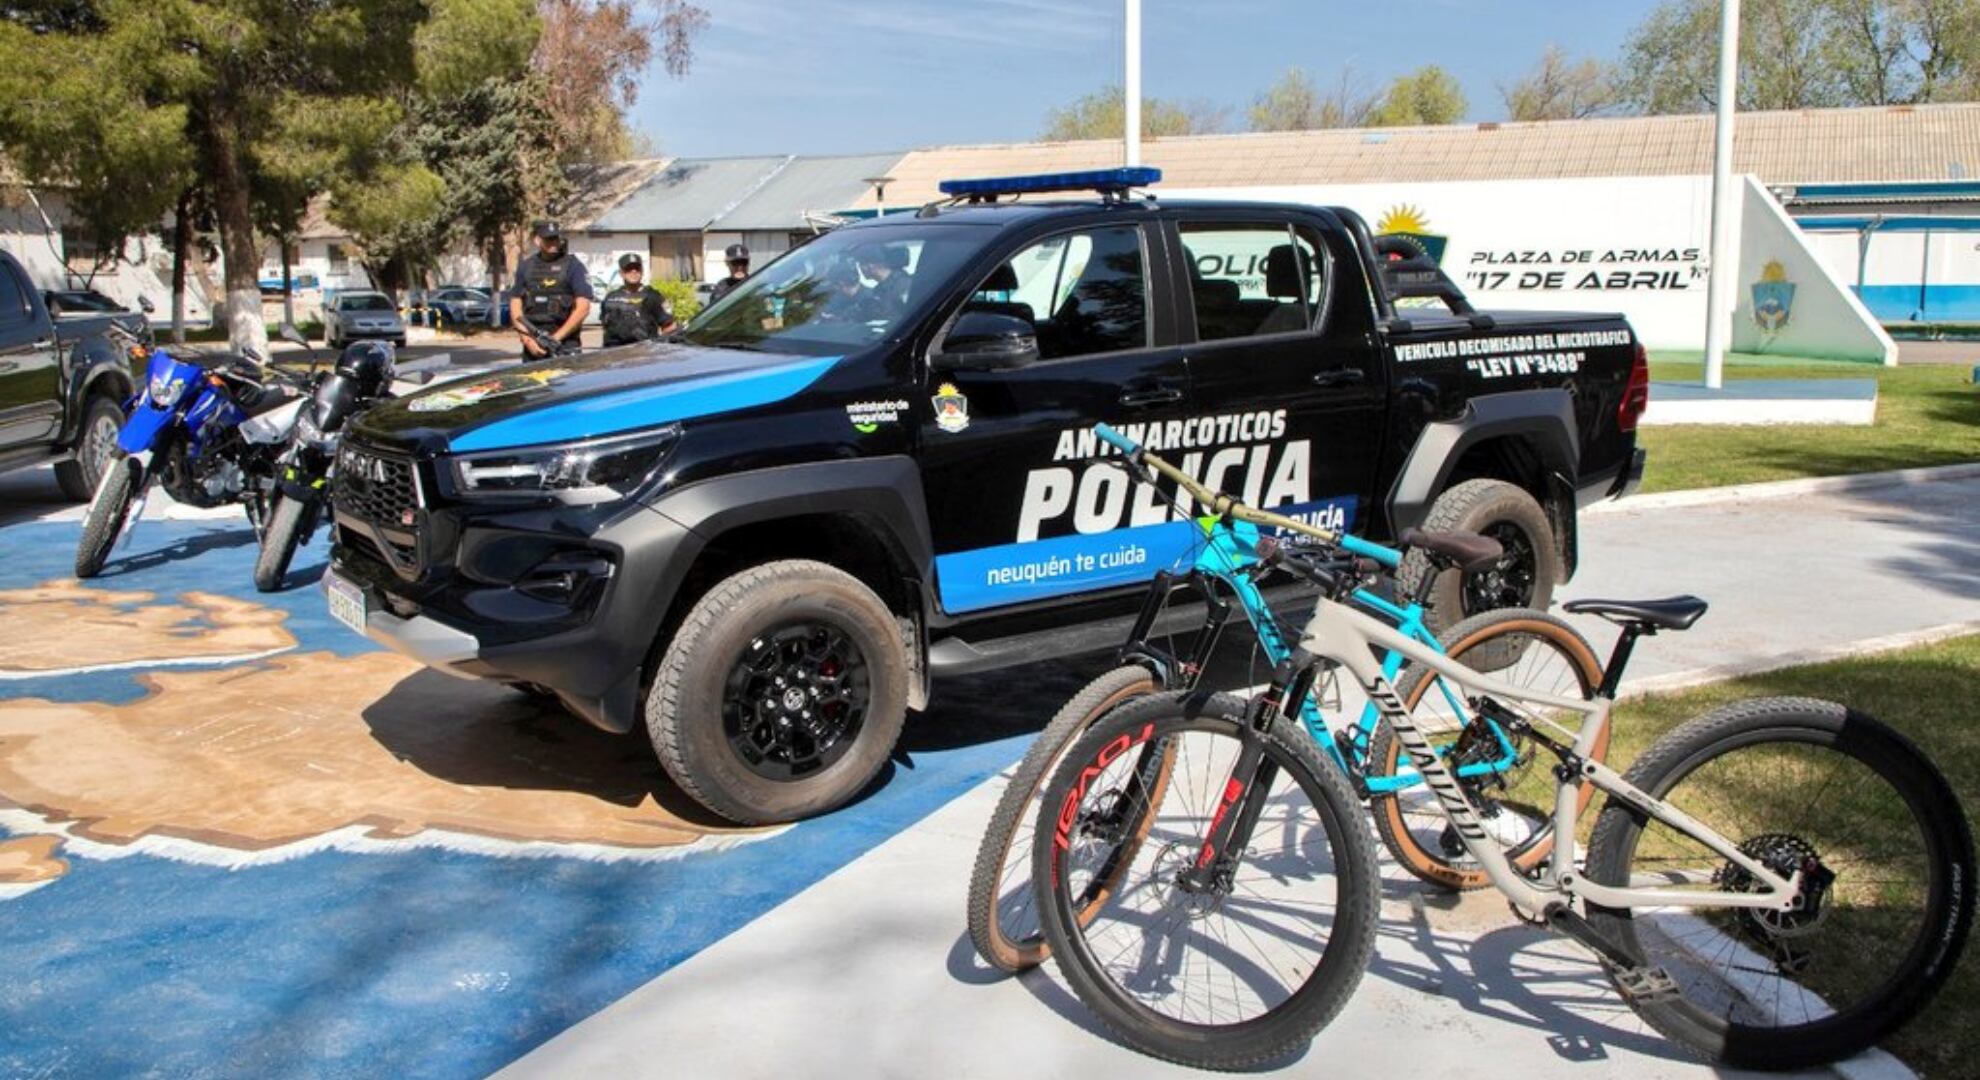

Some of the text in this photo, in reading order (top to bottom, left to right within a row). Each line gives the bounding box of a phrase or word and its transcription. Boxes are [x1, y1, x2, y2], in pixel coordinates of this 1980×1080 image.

[1471, 248, 1700, 264] PLAZA DE ARMAS
[1467, 271, 1510, 290] "17
[1518, 271, 1566, 290] DE
[1394, 329, 1631, 362] VEHICULO DECOMISADO DEL MICROTRAFICO
[850, 410, 898, 425] seguridad
[896, 399, 909, 410] de
[1016, 439, 1312, 543] POLICIA
[987, 544, 1146, 586] neuquén te cuida
[1366, 677, 1487, 840] SPECIALIZED
